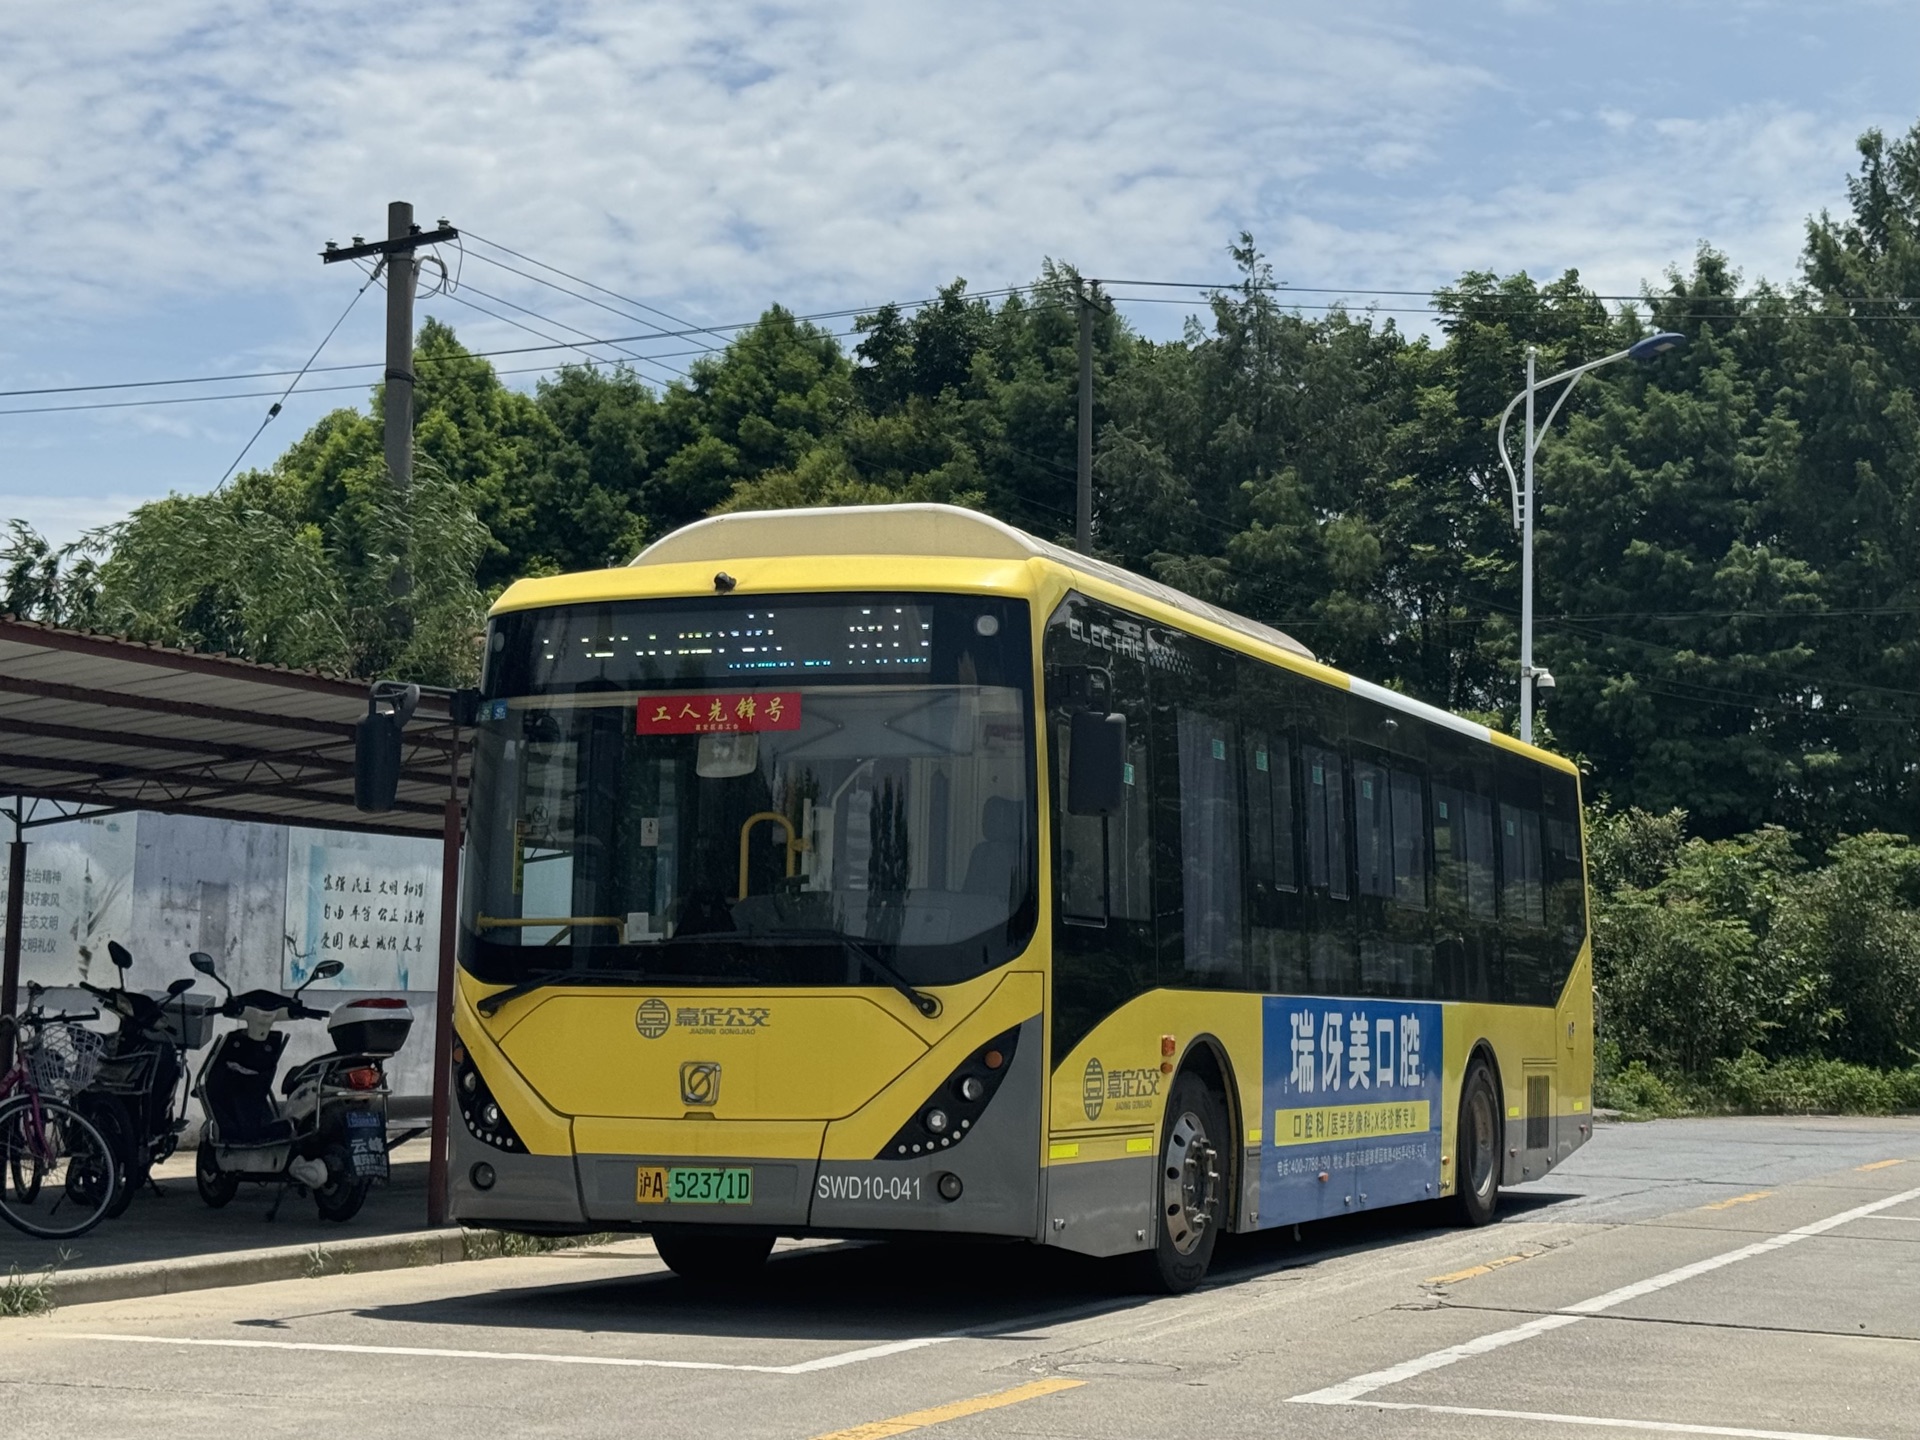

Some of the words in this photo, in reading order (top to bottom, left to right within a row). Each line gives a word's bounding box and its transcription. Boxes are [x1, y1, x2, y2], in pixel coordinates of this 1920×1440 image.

[651, 696, 785, 725] 工人先锋号
[352, 877, 371, 893] 民主
[378, 880, 398, 895] 文明
[324, 903, 344, 920] 自由
[378, 907, 398, 922] 公正
[404, 908, 425, 925] 法治
[321, 931, 343, 950] 爱国
[675, 1007, 771, 1027] 嘉定公交
[1290, 1008, 1420, 1094] 瑞伢美口腔
[1107, 1068, 1160, 1099] 嘉定公交
[817, 1175, 921, 1200] SWD10-041
